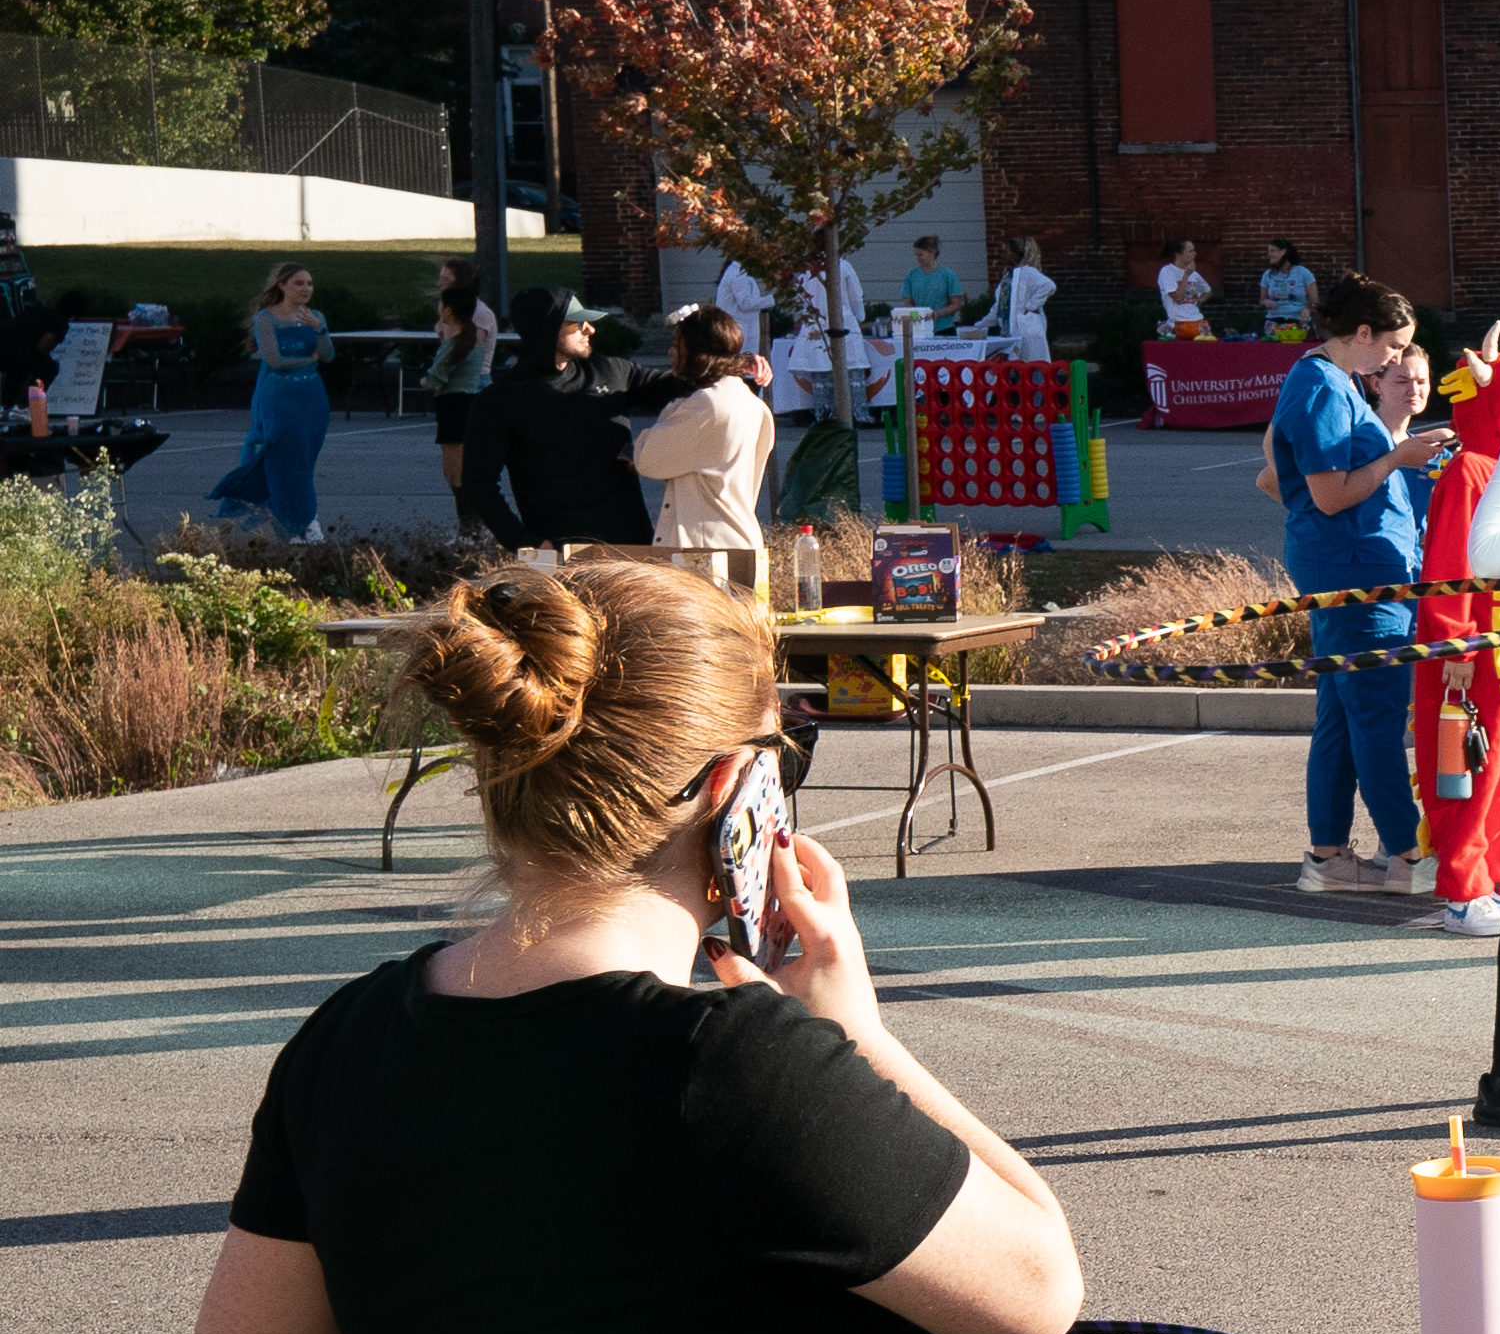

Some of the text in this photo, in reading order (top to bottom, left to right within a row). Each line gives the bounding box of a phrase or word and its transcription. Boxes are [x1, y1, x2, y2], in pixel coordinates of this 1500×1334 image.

[913, 342, 973, 353] euroscience
[1171, 380, 1244, 392] UNIVERSITY
[1172, 387, 1279, 405] CHILDREN'S HOSPITA
[891, 563, 938, 577] OREO
